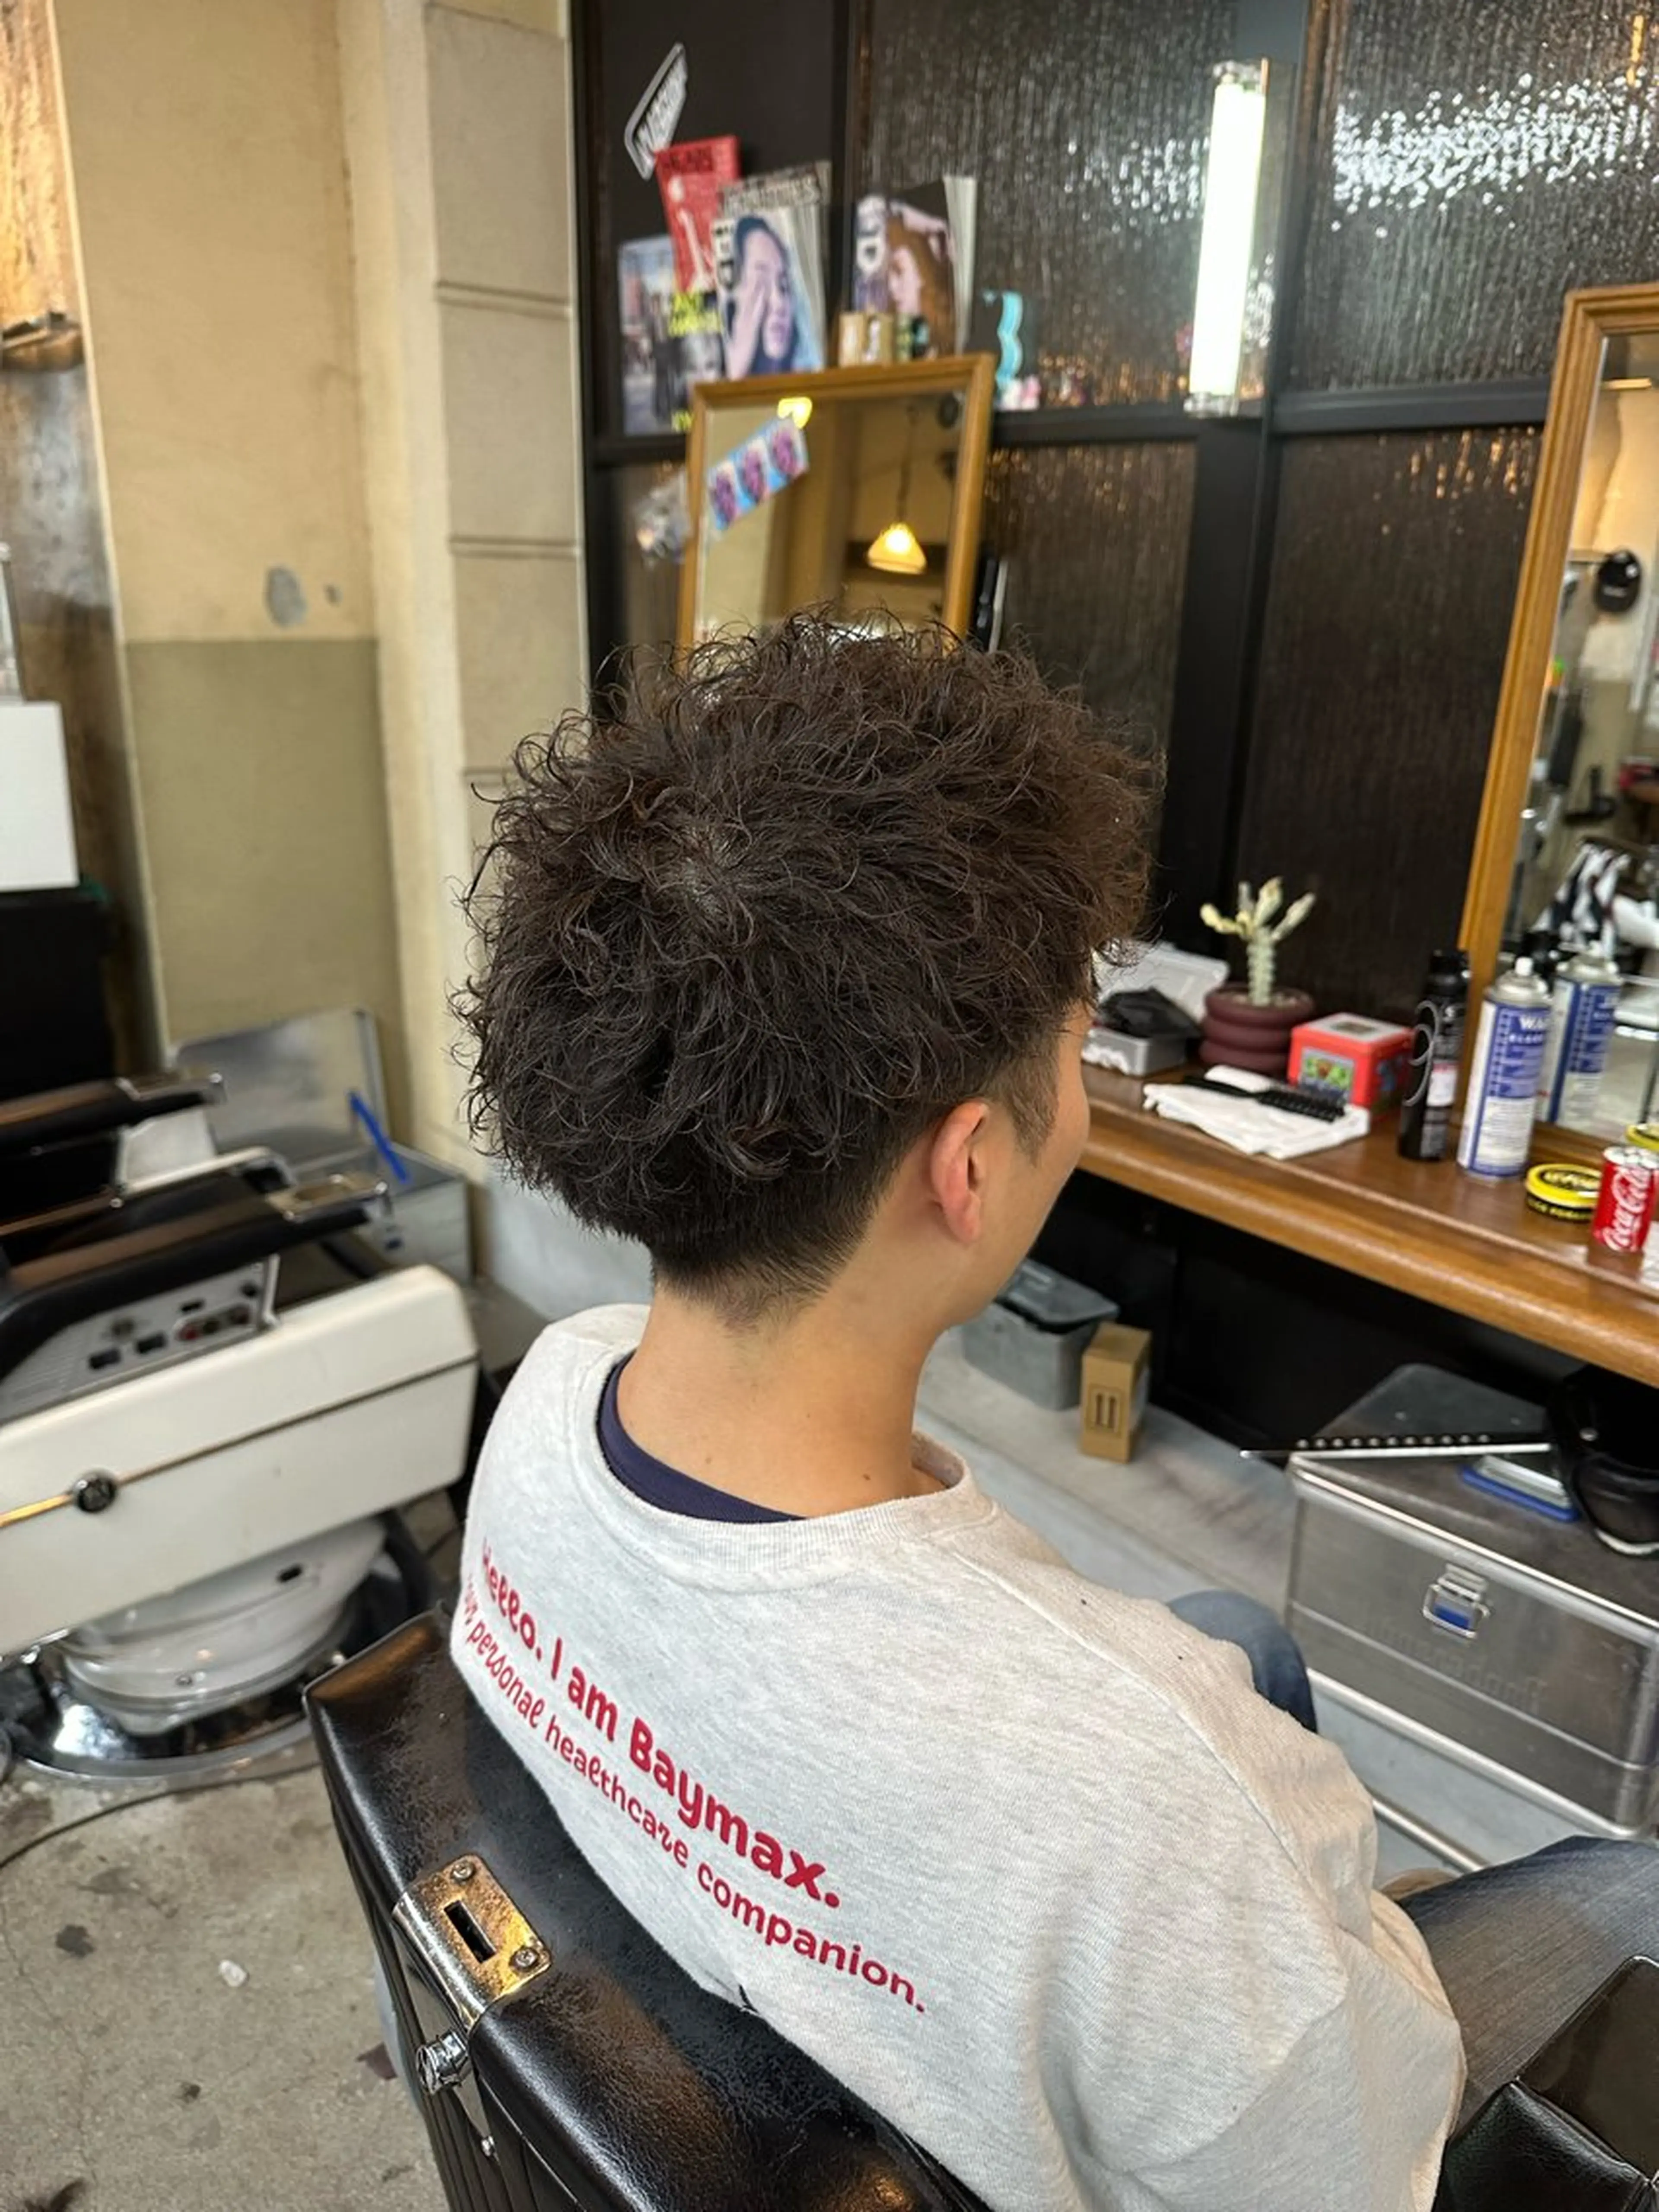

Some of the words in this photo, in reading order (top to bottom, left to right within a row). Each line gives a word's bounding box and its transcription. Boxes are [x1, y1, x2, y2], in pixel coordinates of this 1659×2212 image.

[467, 1620, 545, 1728] personal
[544, 1715, 690, 1870] healthcare
[696, 1862, 926, 2013] companion.
[550, 1637, 563, 1680] I
[567, 1665, 620, 1742] am
[629, 1717, 841, 1908] Baymax.
